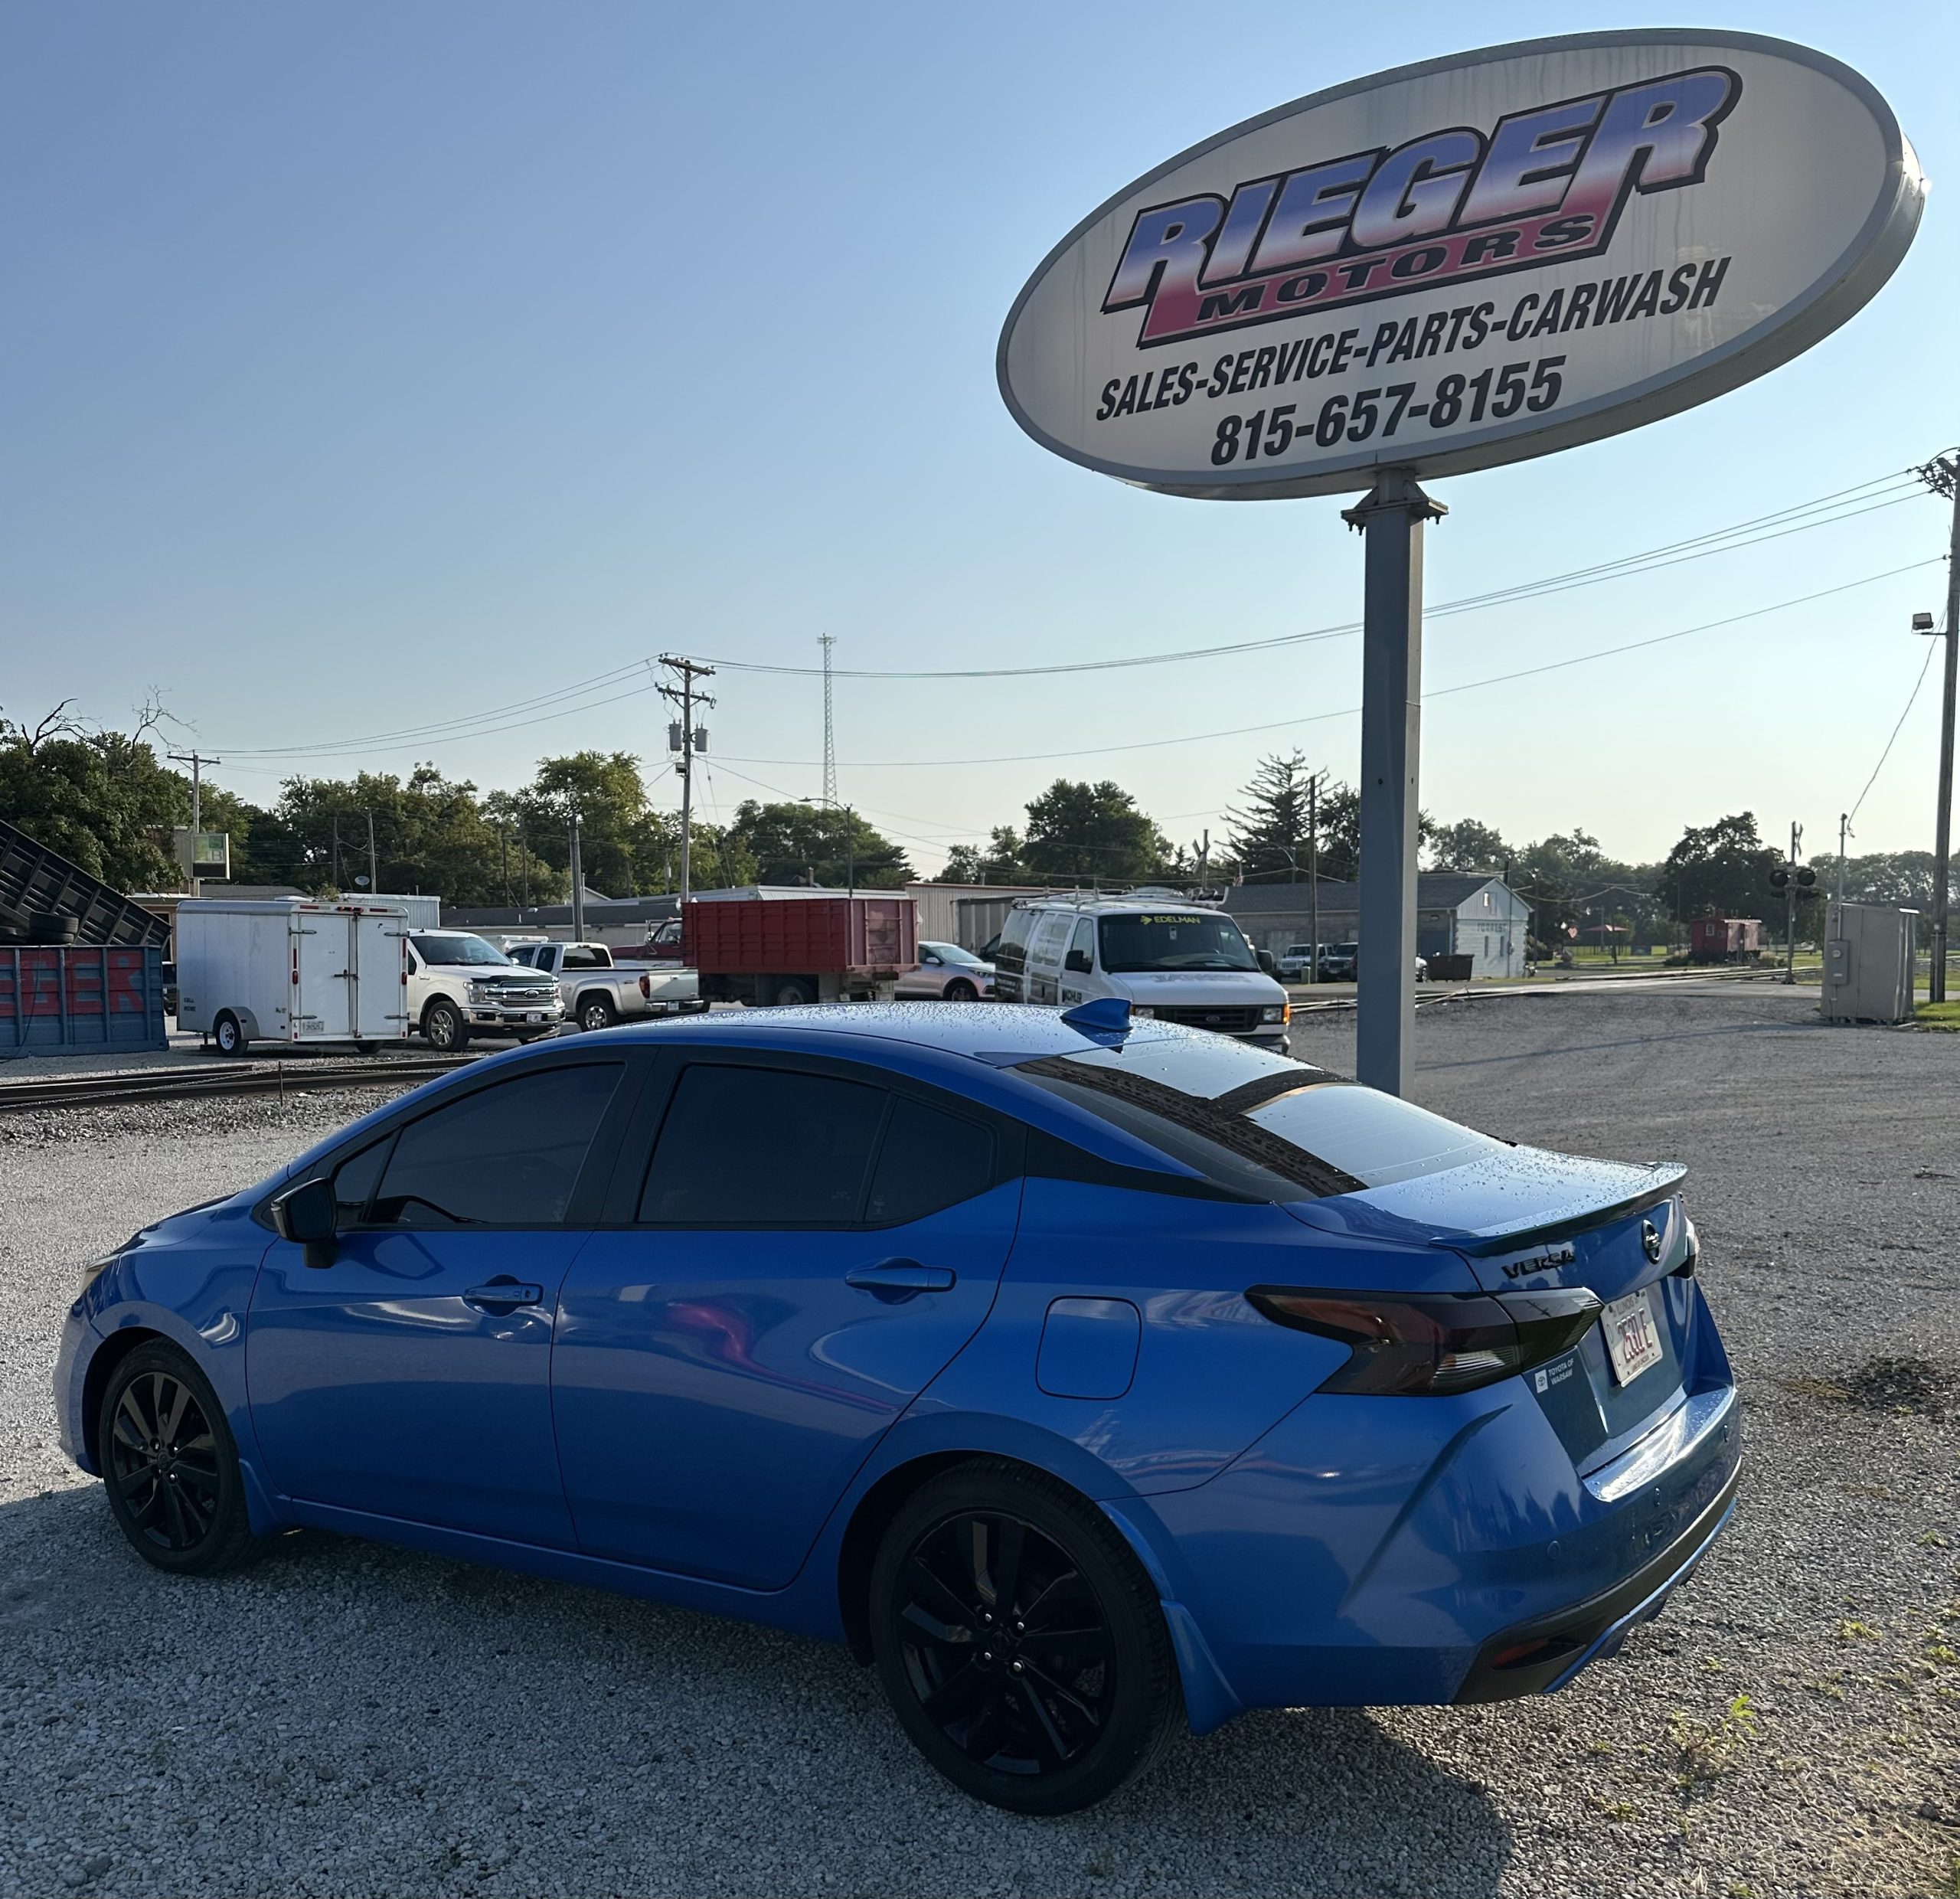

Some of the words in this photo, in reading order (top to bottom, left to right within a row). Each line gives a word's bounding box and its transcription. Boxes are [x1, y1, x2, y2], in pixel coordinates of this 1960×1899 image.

[1102, 66, 1743, 314] RIEGER
[1196, 214, 1596, 322] MOTORS
[1096, 257, 1732, 420] SALES-SERVICE-PARTS-CARWASH
[1210, 355, 1567, 466] 815-657-8155
[1153, 915, 1201, 924] EDELMAN
[1477, 923, 1508, 933] FORREST
[1501, 1250, 1576, 1280] VERSA
[1547, 1362, 1568, 1377] TOYOTA
[1566, 1358, 1574, 1367] OF
